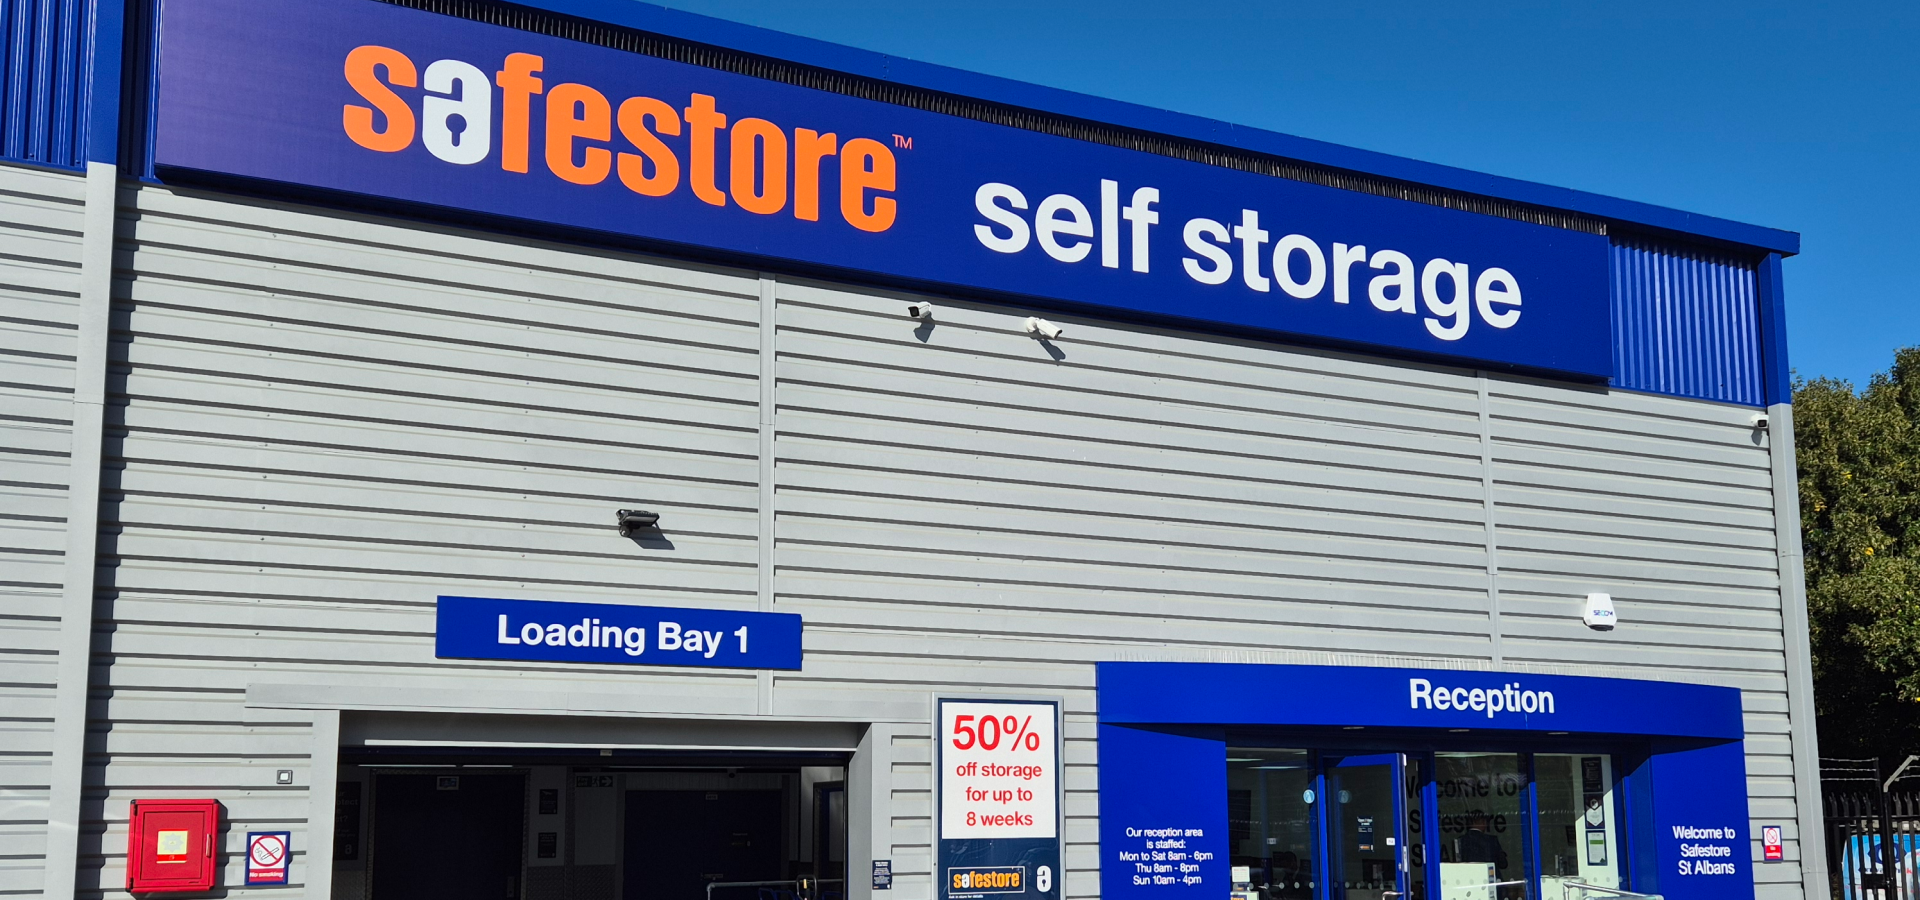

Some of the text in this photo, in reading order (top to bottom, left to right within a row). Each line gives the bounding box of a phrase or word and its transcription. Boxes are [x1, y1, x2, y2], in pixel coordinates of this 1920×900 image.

[343, 45, 897, 233] safestore
[974, 178, 1522, 341] self storage
[497, 614, 748, 659] Loading Bay 1
[1409, 678, 1555, 719] Reception
[952, 714, 1040, 751] 50%
[956, 762, 1042, 780] off storage
[966, 786, 1033, 804] for up to
[966, 811, 1033, 826] 8 weeks
[1126, 827, 1204, 840] Our reception area
[1672, 825, 1736, 839] Welcome to
[1146, 839, 1187, 849] is staffed:
[1680, 843, 1731, 857] Safestore
[1119, 851, 1139, 861] Mon
[1140, 852, 1150, 861] to
[1151, 851, 1166, 861] Sat
[1167, 851, 1187, 861] 8am
[1193, 851, 1213, 862] 6pm
[1135, 863, 1152, 873] Thu
[1153, 863, 1173, 873] 8am
[1180, 863, 1199, 874] 8pm
[1678, 860, 1736, 875] St Albans
[953, 871, 1020, 889] safestore
[1133, 875, 1150, 886] Sun
[1152, 875, 1175, 885] 10am
[1182, 875, 1202, 886] 4pm
